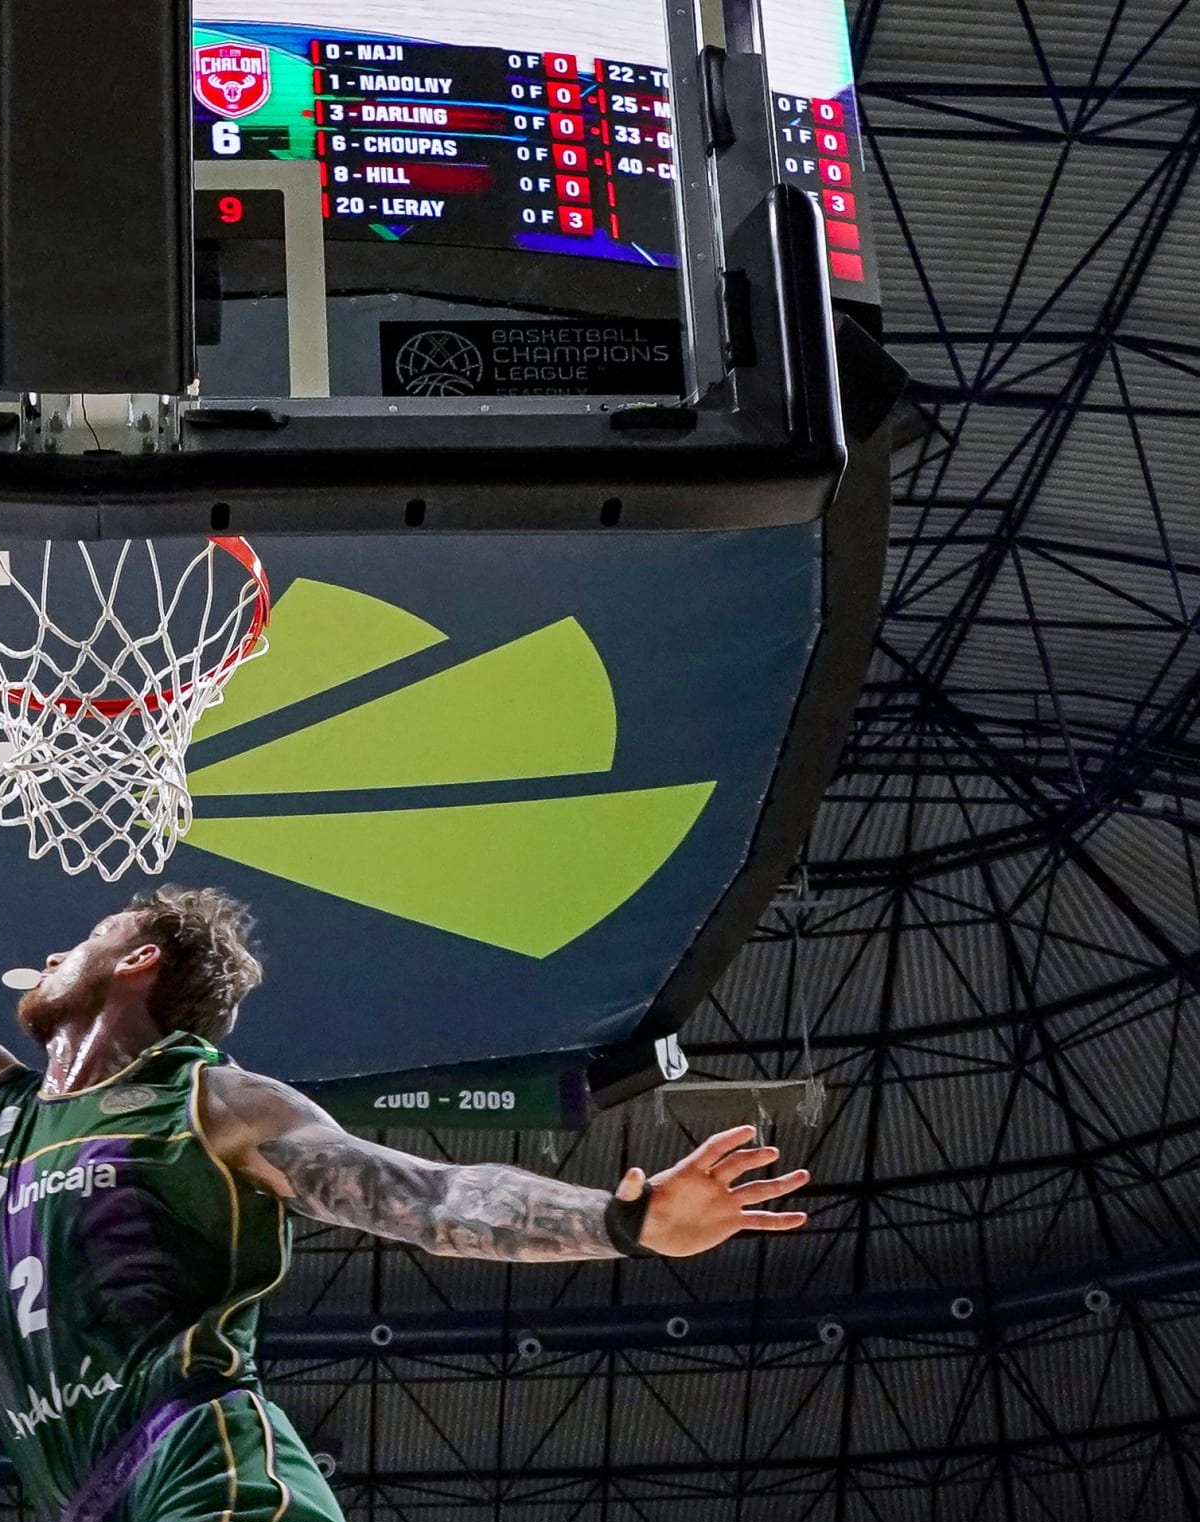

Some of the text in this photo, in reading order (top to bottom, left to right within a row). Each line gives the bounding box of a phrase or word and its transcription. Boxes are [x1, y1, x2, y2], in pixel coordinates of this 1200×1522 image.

[200, 57, 262, 75] CHALON
[326, 44, 567, 73] 0 NAJI 0 F 0
[608, 65, 634, 83] 22
[330, 74, 570, 103] 1 NADOLNY 0 F 0
[612, 95, 638, 113] 25
[778, 98, 834, 120] 0 F 0
[330, 105, 574, 134] 3 DARLING 0 F 0
[211, 121, 241, 154] 6
[615, 126, 641, 144] 33
[783, 128, 838, 150] 1 F 0
[332, 135, 457, 156] 6 CHOUPAS
[334, 166, 410, 184] 8 HILL
[618, 158, 644, 175] 40
[218, 196, 243, 223] 9
[336, 197, 445, 217] 20 LERAY
[492, 328, 649, 343] BASKETBALL
[493, 345, 670, 364] CHAMPIONS
[494, 366, 589, 381] LEAGUE
[374, 1091, 516, 1110] 2000 2009
[7, 1158, 117, 1215] Unicaja
[10, 1255, 49, 1339] 2
